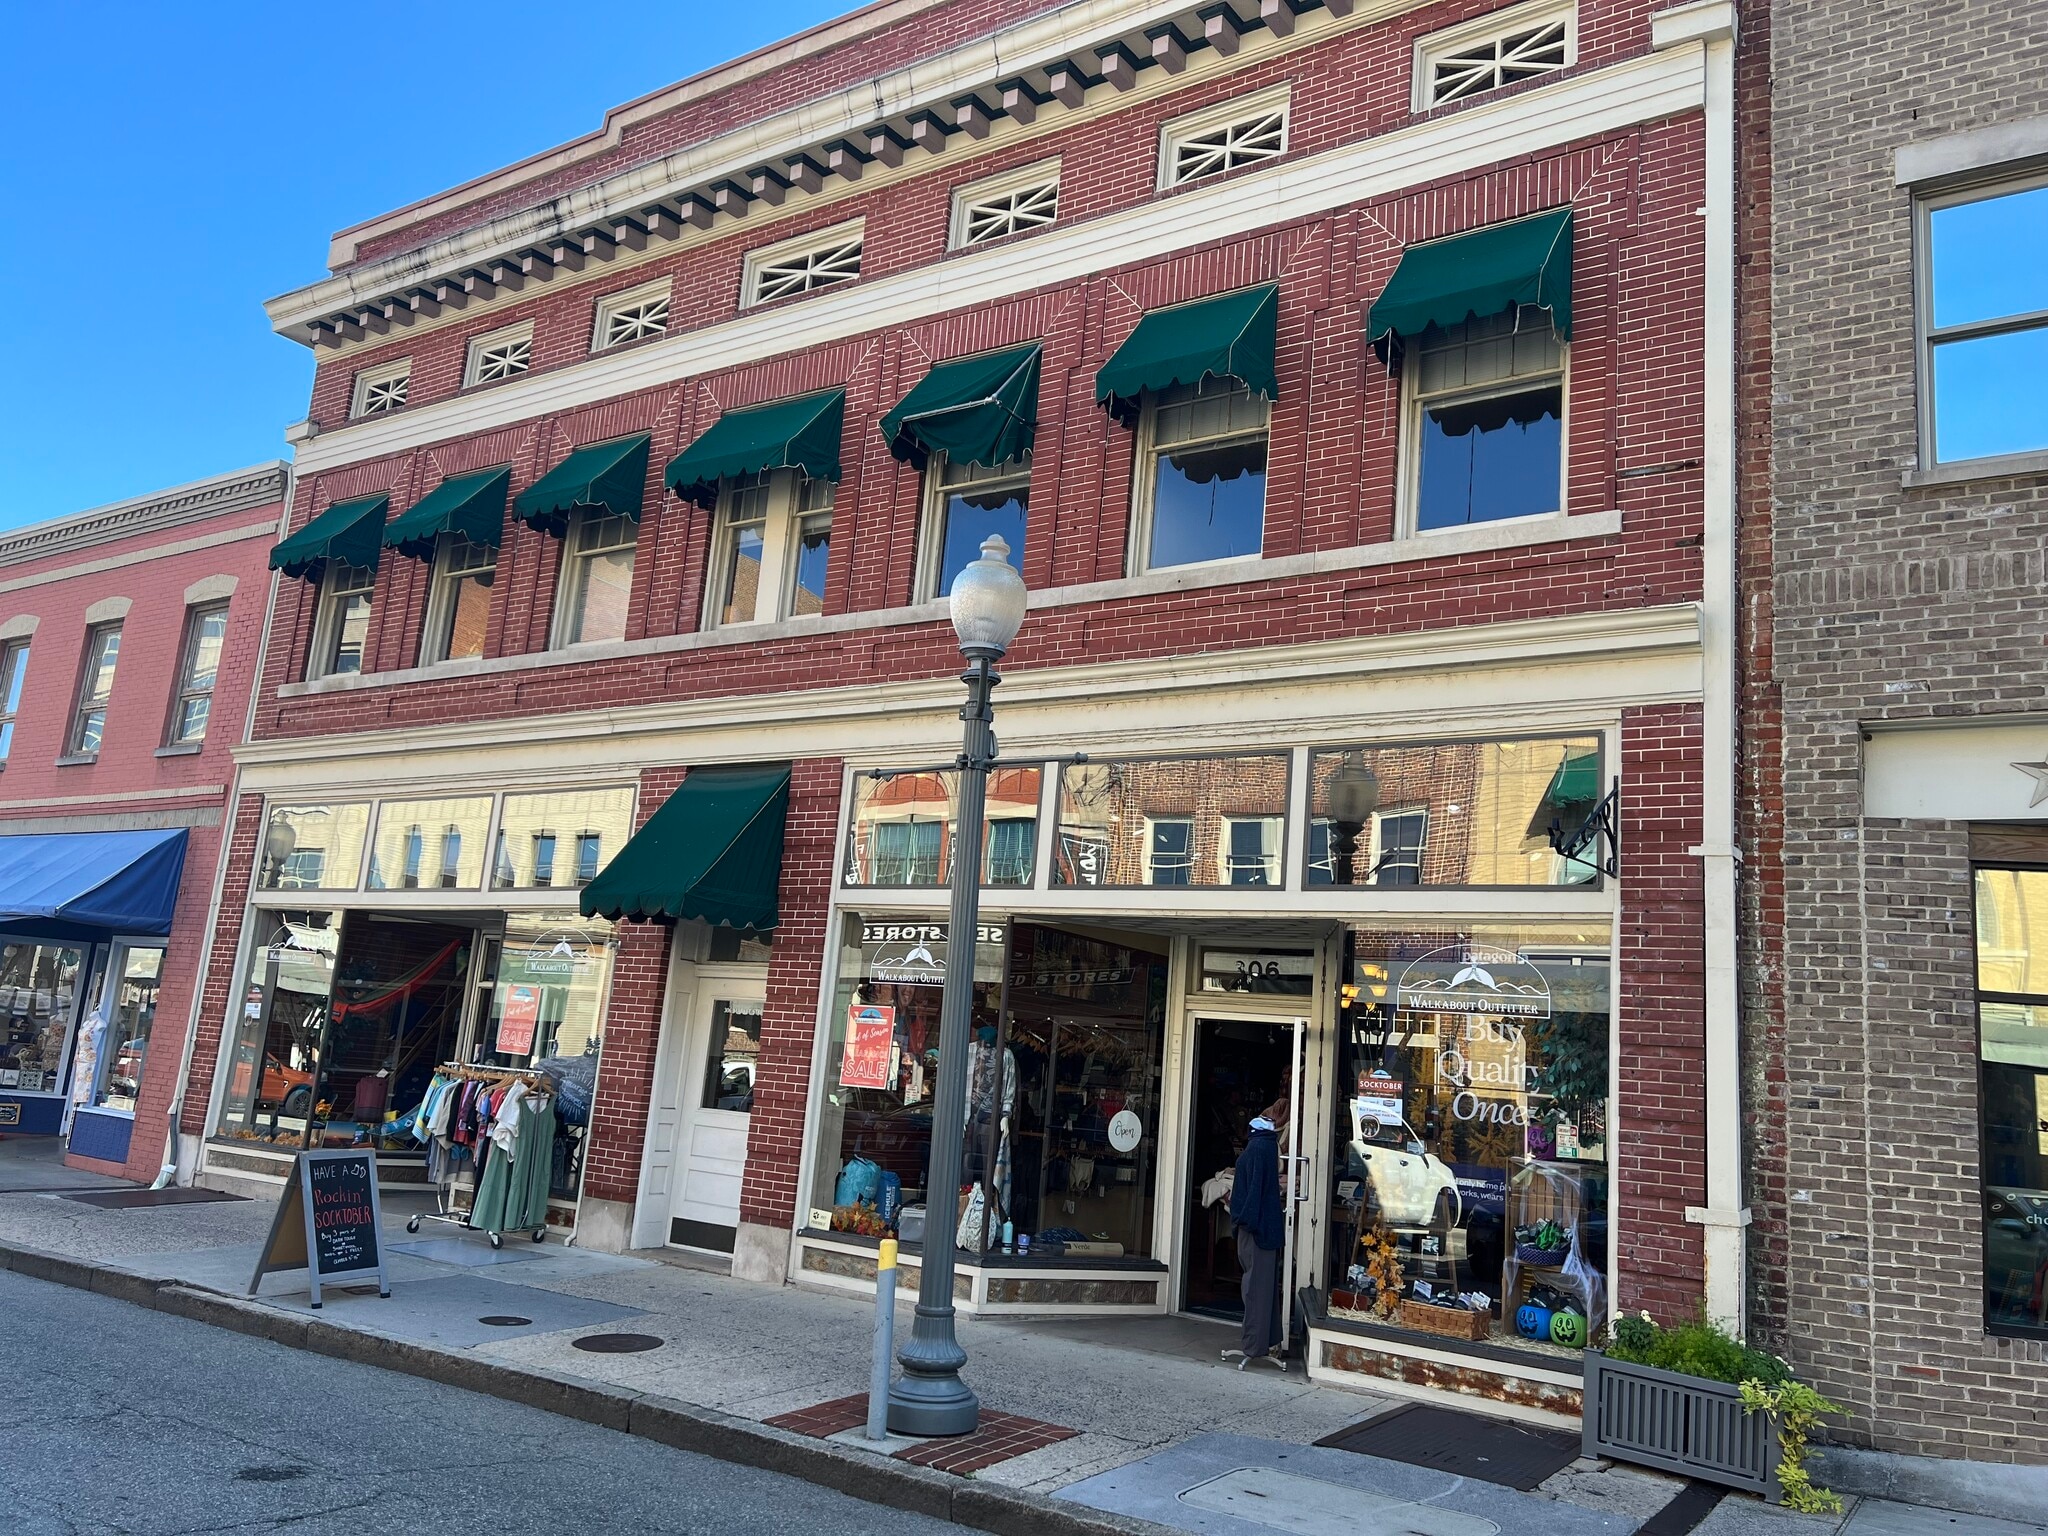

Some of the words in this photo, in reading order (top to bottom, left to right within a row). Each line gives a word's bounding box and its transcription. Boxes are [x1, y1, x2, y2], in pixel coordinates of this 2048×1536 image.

[1462, 951, 1528, 964] patagona
[878, 970, 920, 983] WALKABOUT
[920, 973, 945, 984] OUTFIT
[1036, 970, 1121, 985] STORES
[1235, 960, 1279, 980] 306
[1409, 994, 1476, 1011] WALKABOUT
[1478, 999, 1538, 1014] OUTFITTER
[500, 1030, 531, 1047] SALE
[1464, 1014, 1526, 1053] Buy
[844, 1060, 887, 1080] SALE
[1440, 1050, 1548, 1095] Quality
[1360, 1080, 1402, 1090] SOCKTOBER
[1453, 1092, 1531, 1126] Once
[1115, 1120, 1134, 1138] Open
[313, 1165, 336, 1181] HAVE
[342, 1165, 349, 1176] A
[1477, 1181, 1498, 1190] home
[314, 1185, 364, 1206] Rockin'
[884, 1185, 892, 1219] ICEMULE
[1460, 1190, 1479, 1199] orks,
[1480, 1193, 1504, 1201] wears
[315, 1205, 371, 1228] SOCKTOBER
[321, 1232, 332, 1243] Buy
[332, 1229, 338, 1237] 3
